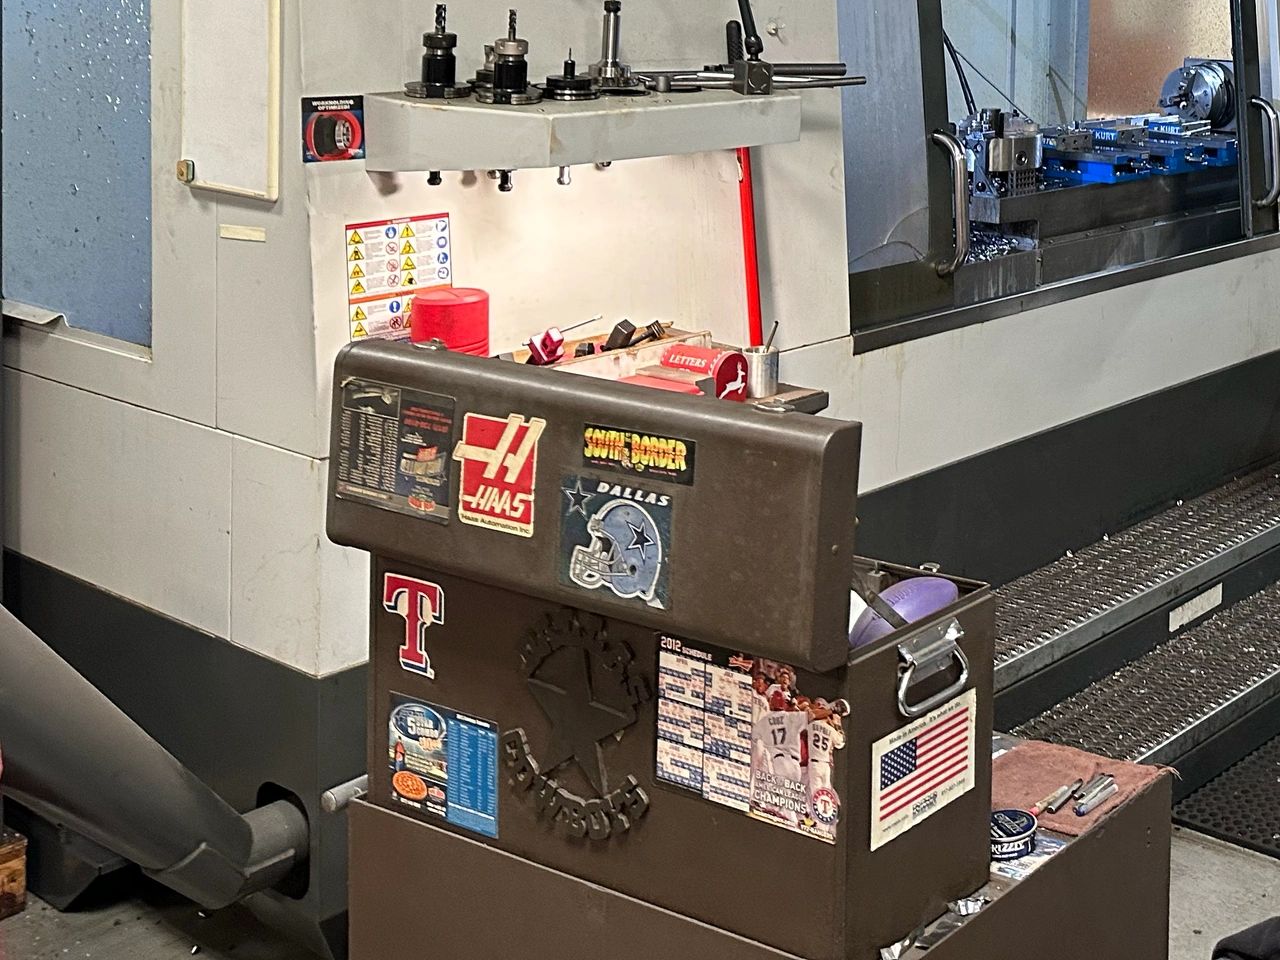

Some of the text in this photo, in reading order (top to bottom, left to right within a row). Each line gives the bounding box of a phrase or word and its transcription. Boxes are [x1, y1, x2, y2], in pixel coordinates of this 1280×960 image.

[1095, 131, 1115, 141] KURT
[1160, 125, 1180, 134] KURT
[669, 354, 707, 368] LETTERS
[584, 428, 687, 472] SOUTH BORDER
[462, 485, 534, 518] HAAS
[597, 482, 672, 507] DALLAS
[461, 514, 531, 534] Haas Automation Inc.
[384, 573, 444, 676] T
[660, 636, 712, 661] 2012 SCHEDULE
[407, 716, 416, 735] 5
[771, 727, 786, 745] 17
[813, 733, 829, 752] 25
[889, 735, 902, 744] Made
[755, 770, 807, 793] BACK BACK
[754, 790, 807, 814] CHAMPIONS
[991, 841, 1025, 855] RIZZLY
